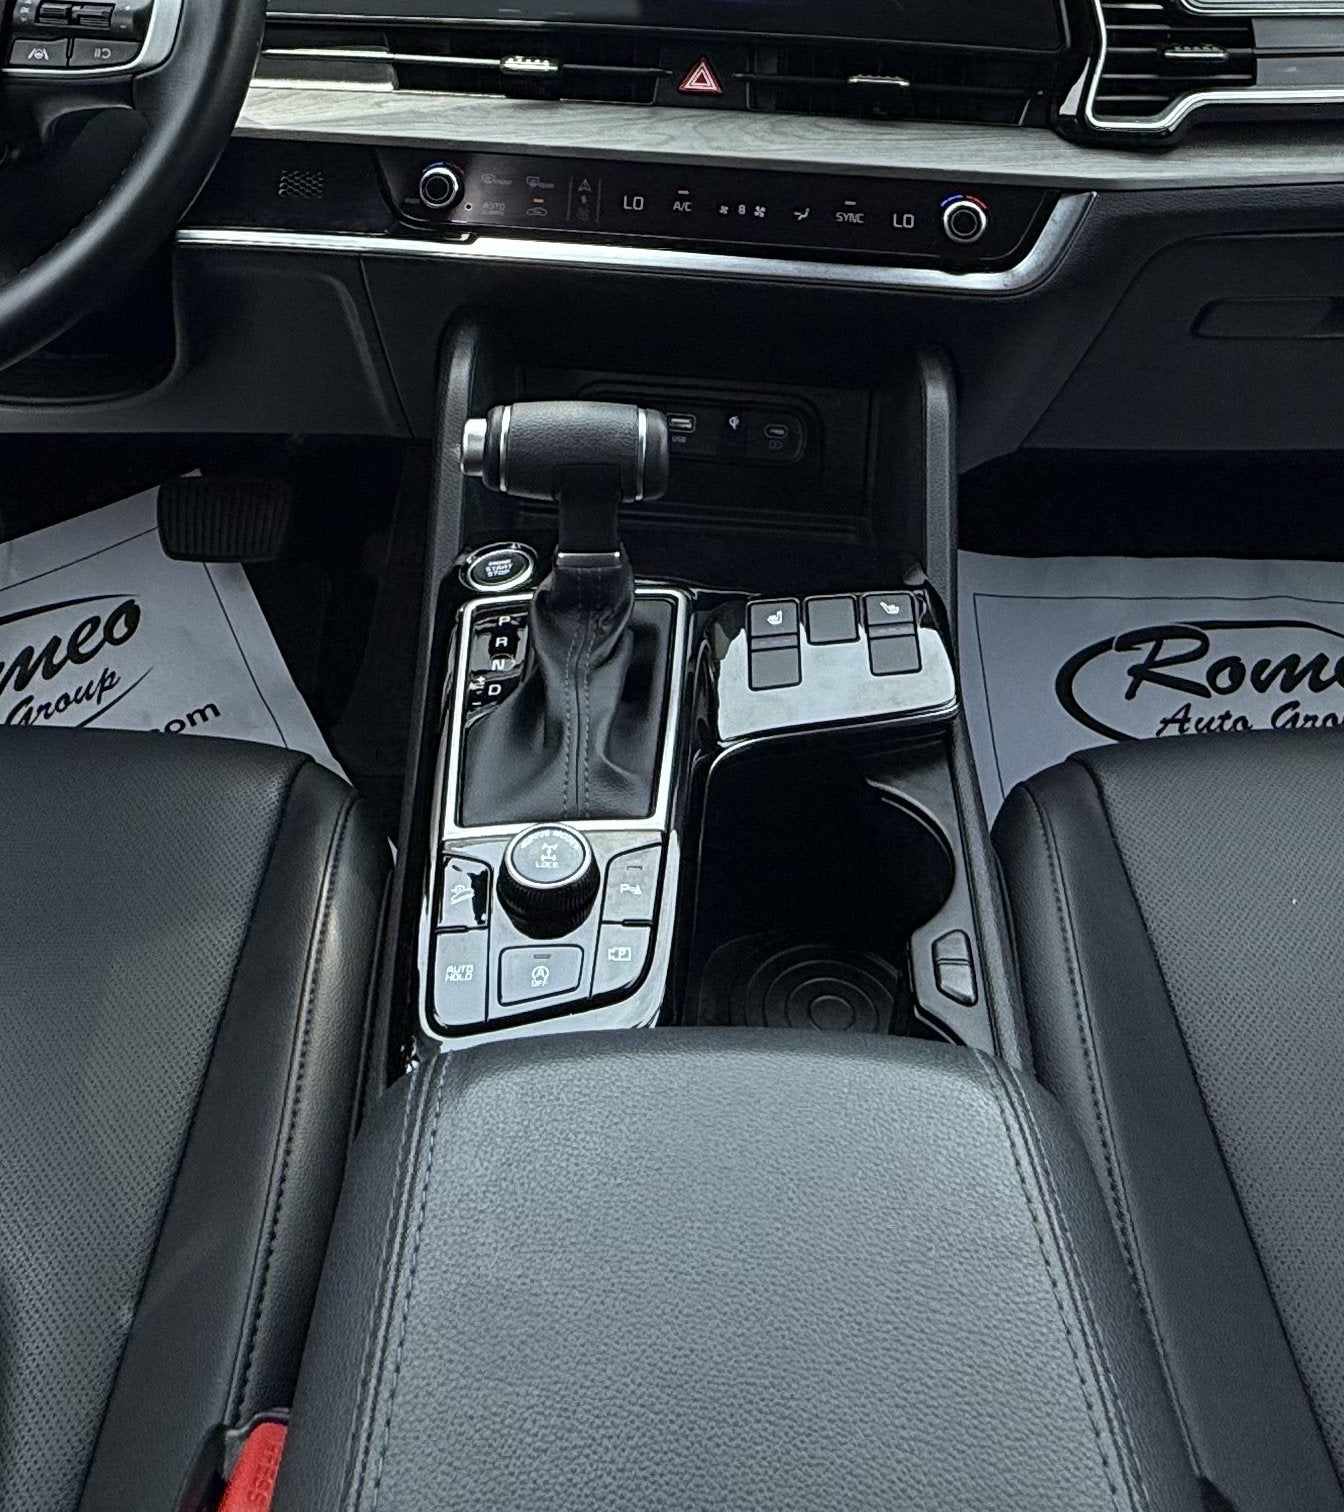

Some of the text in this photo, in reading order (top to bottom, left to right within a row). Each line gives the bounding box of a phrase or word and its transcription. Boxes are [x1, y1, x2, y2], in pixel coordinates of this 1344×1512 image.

[623, 195, 644, 210] LO
[672, 201, 693, 212] A/C
[835, 211, 864, 224] SYNC
[892, 213, 915, 229] LO
[495, 637, 508, 648] R
[491, 659, 506, 670] N
[487, 684, 502, 696] D
[1156, 701, 1252, 735] Auto
[446, 964, 474, 974] AUTO
[445, 973, 473, 983] HOLD
